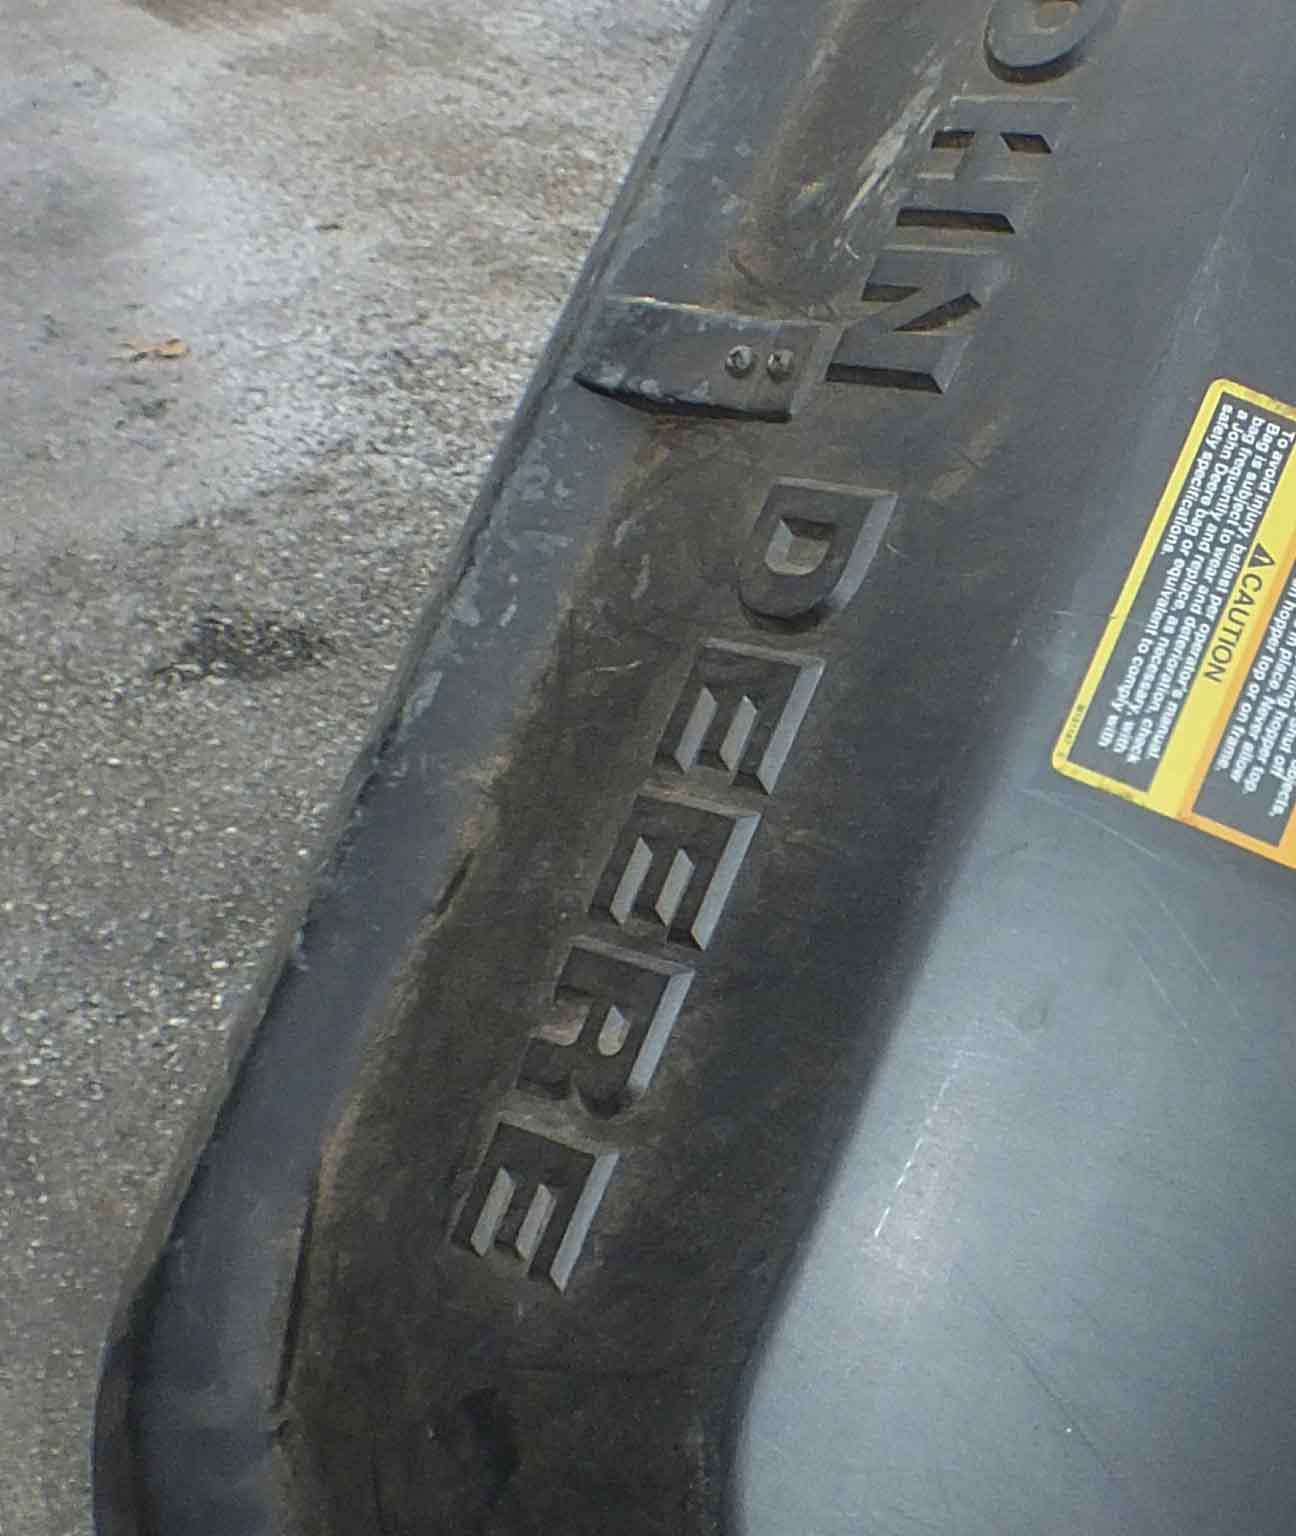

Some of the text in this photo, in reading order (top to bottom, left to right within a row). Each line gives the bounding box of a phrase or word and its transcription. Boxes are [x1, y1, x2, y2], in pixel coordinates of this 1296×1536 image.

[1240, 415, 1266, 444] bag
[1255, 422, 1280, 453] Bag
[1276, 431, 1296, 448] To
[1159, 403, 1233, 554] safety specifications.
[1250, 454, 1267, 469] is
[1257, 450, 1283, 493] avoid
[1208, 447, 1252, 522] frequently
[1226, 471, 1256, 528] subject
[1197, 522, 1218, 553] and
[1219, 527, 1235, 544] to
[1097, 409, 1248, 746] a John Deere bag or equivalent to comply with
[1203, 546, 1226, 583] wear
[1215, 543, 1247, 593] ballast
[1189, 584, 1209, 615] and
[1204, 593, 1222, 621] per
[1162, 615, 1178, 634] as
[1203, 573, 1262, 682] CAUTION
[1265, 599, 1296, 653] hopper
[1252, 654, 1274, 680] top
[1265, 647, 1292, 692] place.
[1245, 682, 1260, 701] or
[1235, 701, 1252, 722] on
[1248, 695, 1278, 740] Never
[1112, 720, 1135, 752] with
[1214, 724, 1245, 770] frame.
[1256, 709, 1288, 764] hopper
[1229, 740, 1254, 782] allow
[1269, 754, 1285, 780] off
[448, 476, 897, 1295] DEERE
